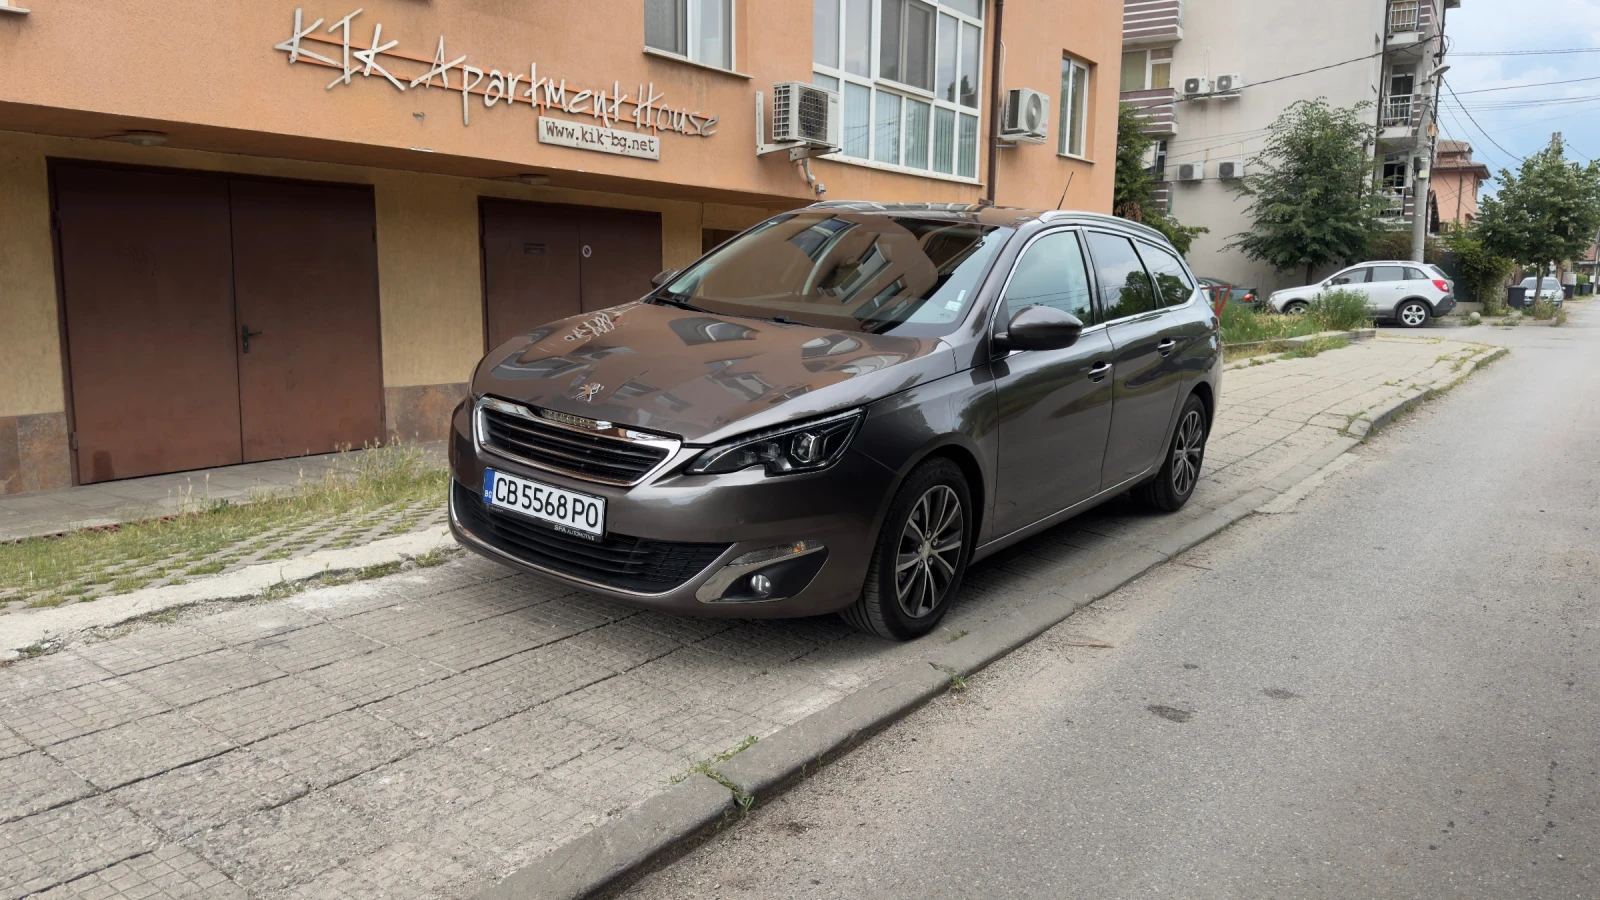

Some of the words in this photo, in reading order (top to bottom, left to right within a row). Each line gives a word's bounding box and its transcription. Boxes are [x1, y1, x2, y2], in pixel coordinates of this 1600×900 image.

[410, 35, 628, 126] Apartment
[633, 82, 719, 137] House
[484, 490, 493, 498] BG
